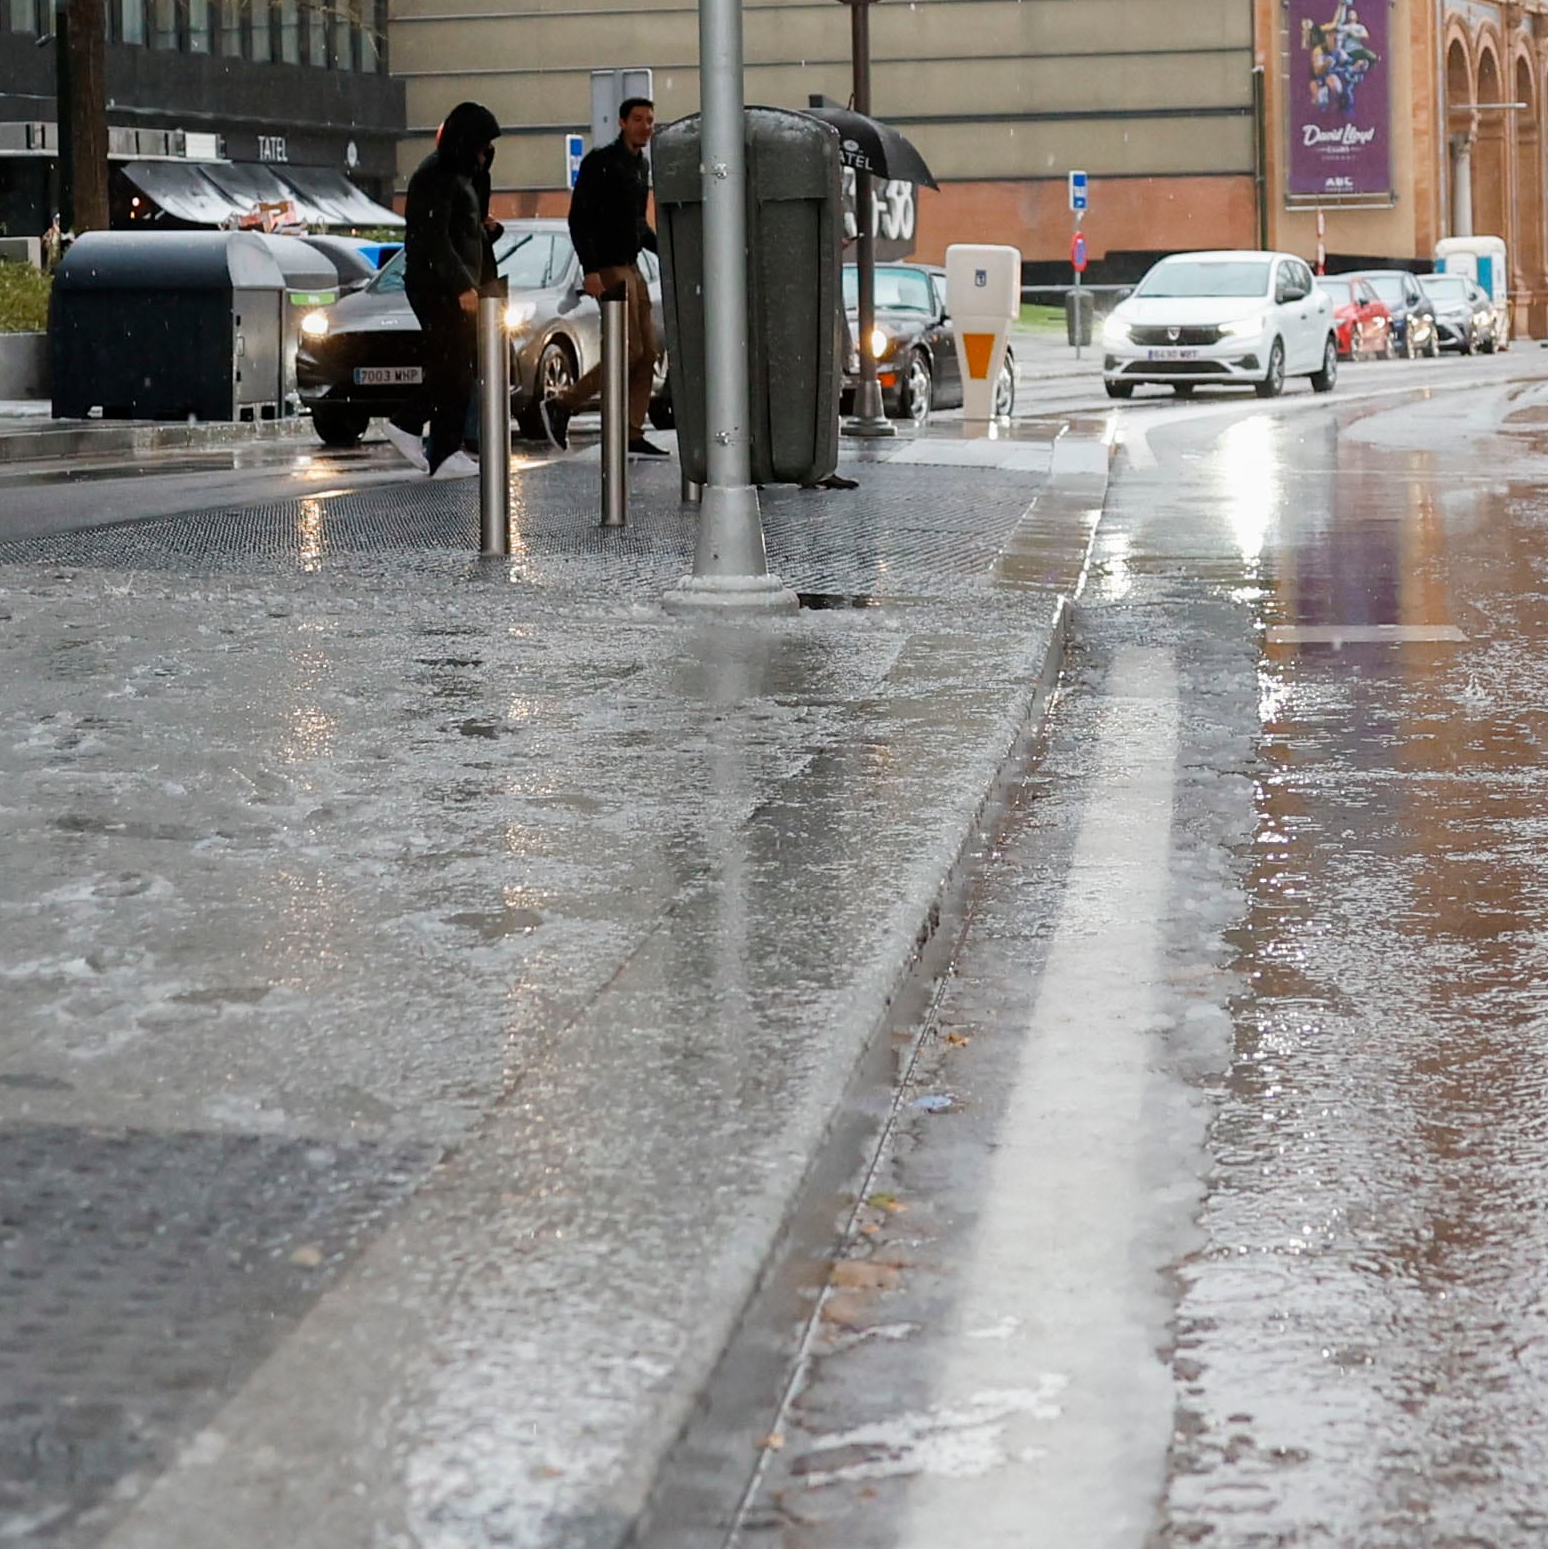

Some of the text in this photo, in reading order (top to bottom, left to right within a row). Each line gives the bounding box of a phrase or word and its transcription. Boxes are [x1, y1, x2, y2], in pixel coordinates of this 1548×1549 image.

[1302, 123, 1375, 146] David Lloyd
[257, 135, 288, 162] TATEL
[1325, 177, 1354, 186] ABC
[361, 369, 391, 382] 7003
